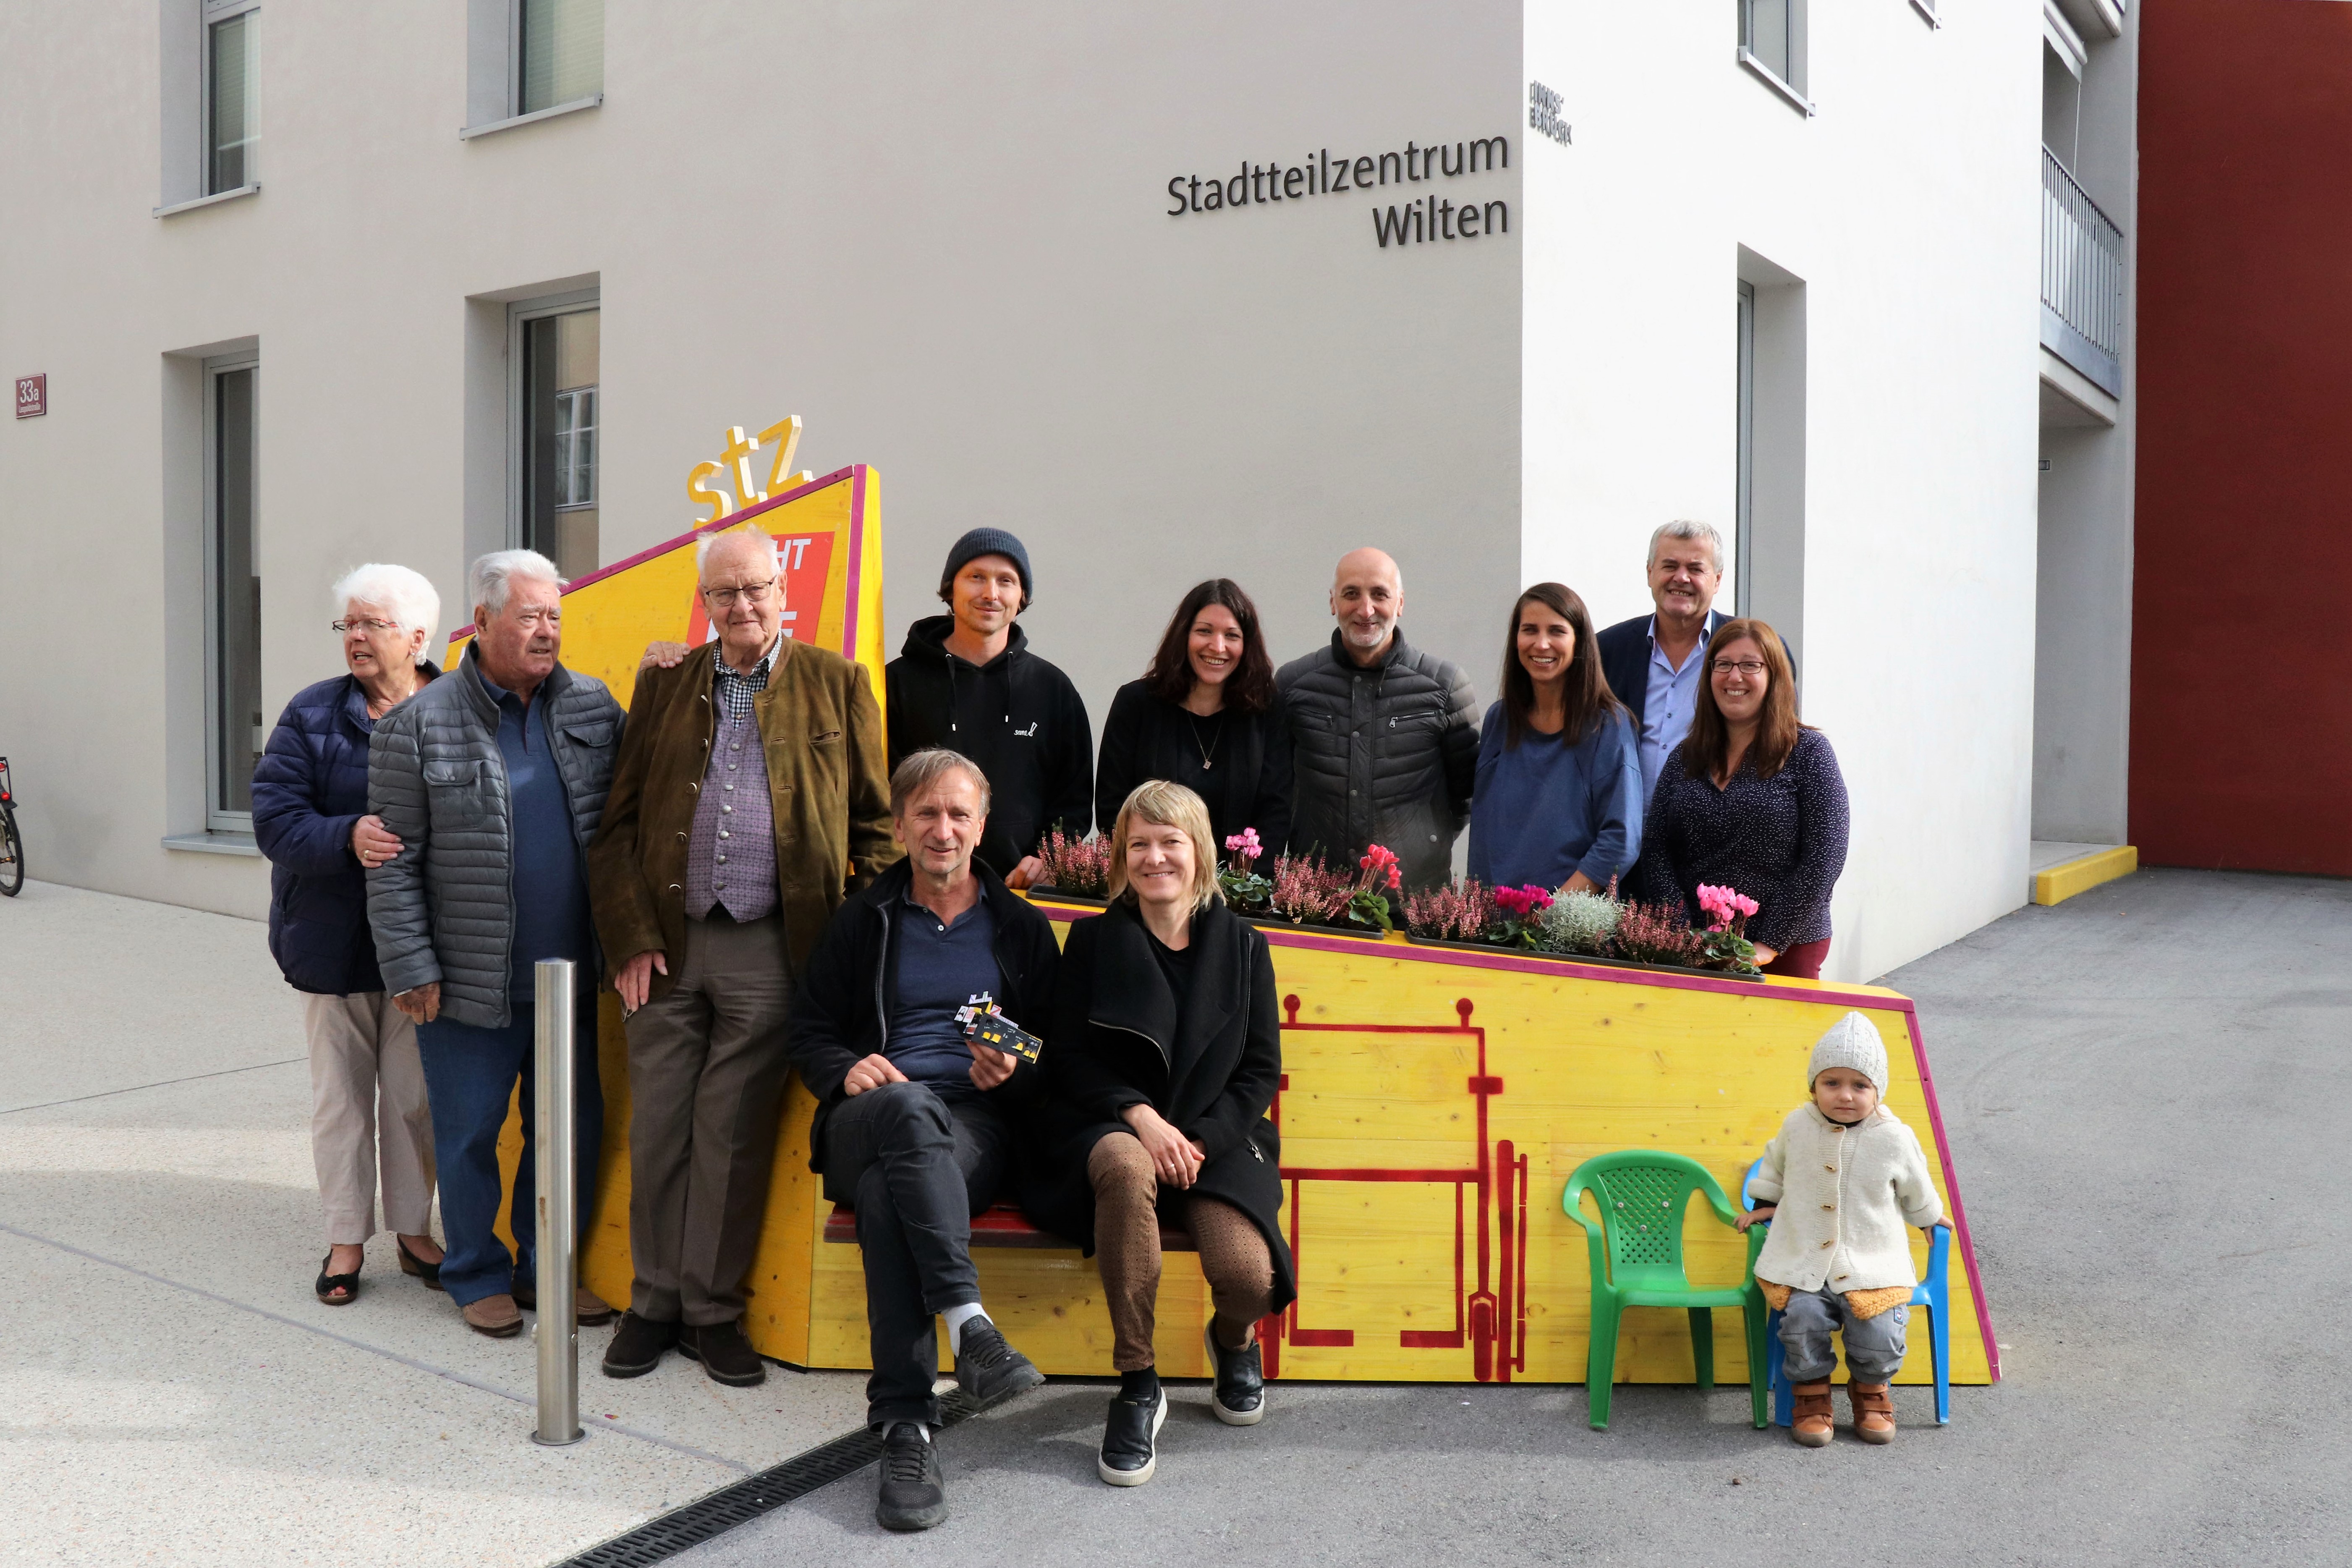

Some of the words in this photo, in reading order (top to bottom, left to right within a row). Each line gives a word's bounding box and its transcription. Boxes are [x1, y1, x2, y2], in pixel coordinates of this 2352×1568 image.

[1534, 102, 1572, 145] BRUCK
[1167, 136, 1508, 216] Stadtteilzentrum
[1372, 195, 1507, 248] Wilten
[20, 380, 39, 403] 33a
